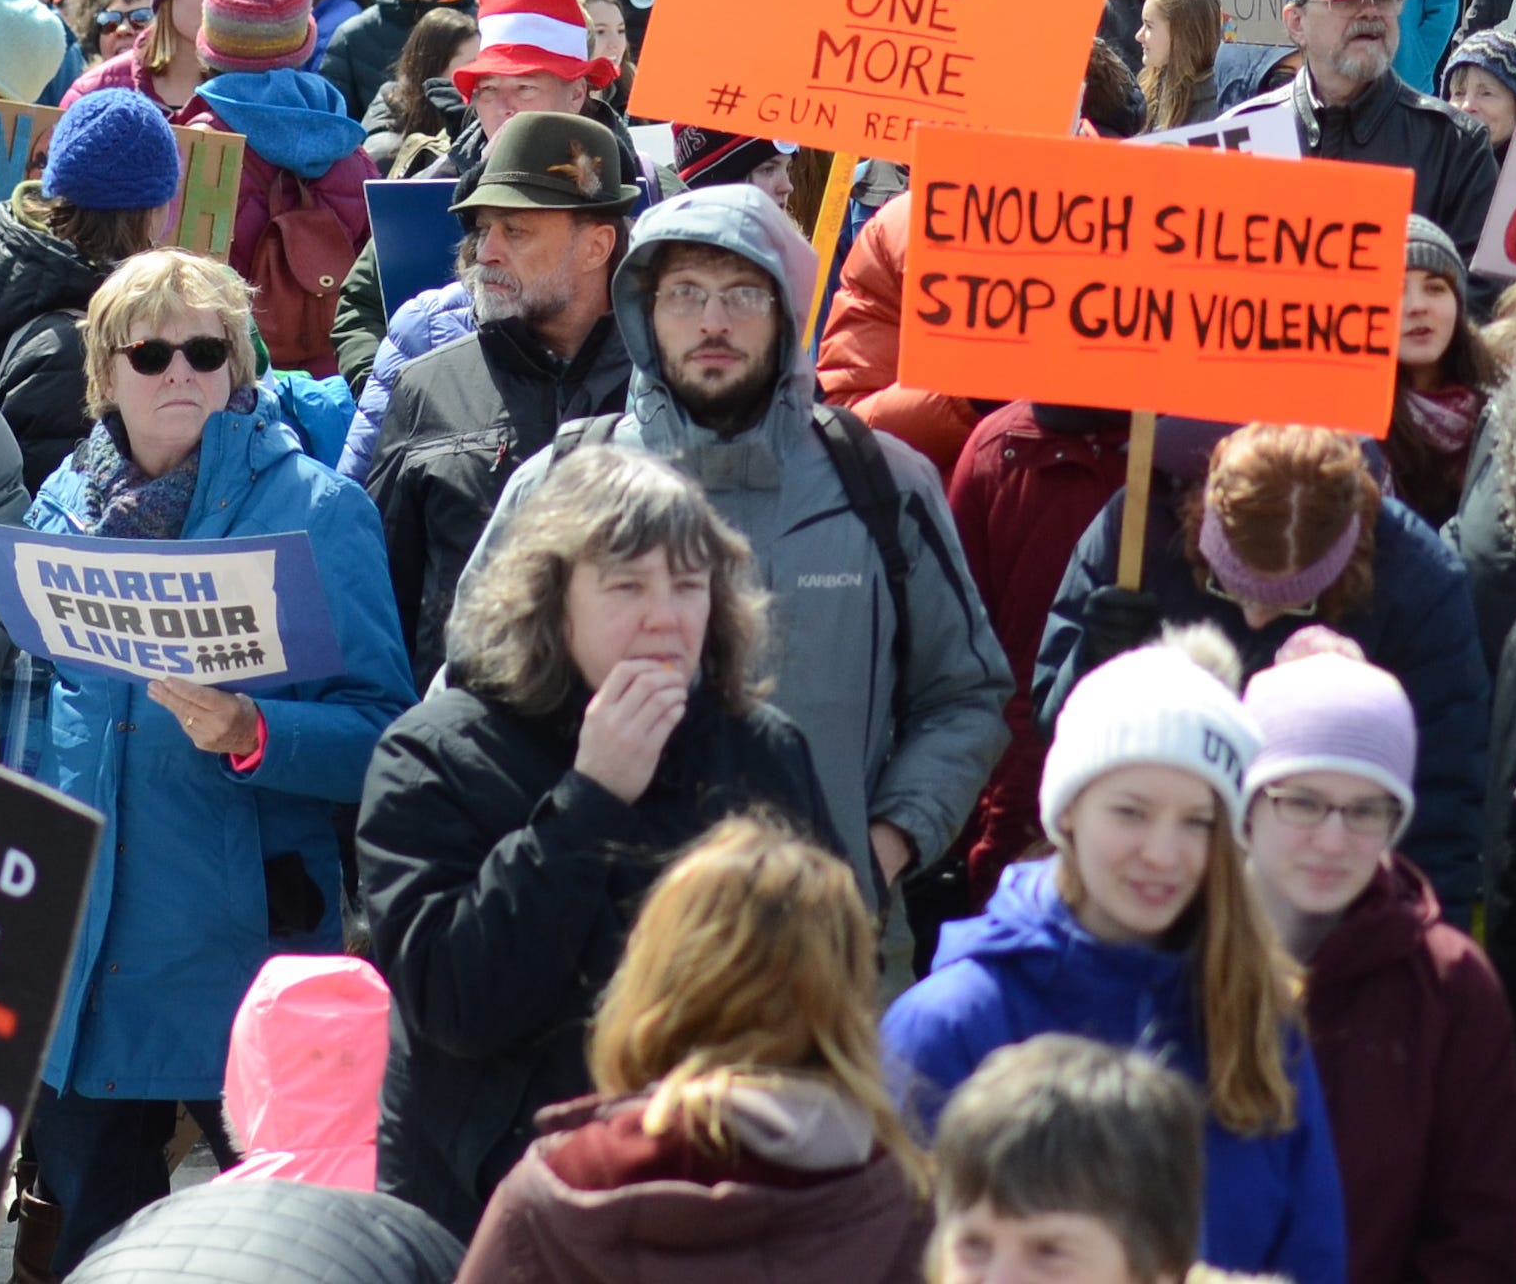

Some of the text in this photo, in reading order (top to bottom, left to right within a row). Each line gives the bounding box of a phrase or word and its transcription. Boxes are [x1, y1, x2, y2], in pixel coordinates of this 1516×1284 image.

[811, 30, 977, 99] MORE
[925, 182, 1382, 271] ENOUGH SILENCE
[917, 273, 1391, 357] STOP GUN VIOLENCE
[37, 560, 218, 602] MARCH
[797, 574, 861, 588] KARBON
[46, 592, 260, 639] FOR OUR
[59, 624, 195, 675] LIVES
